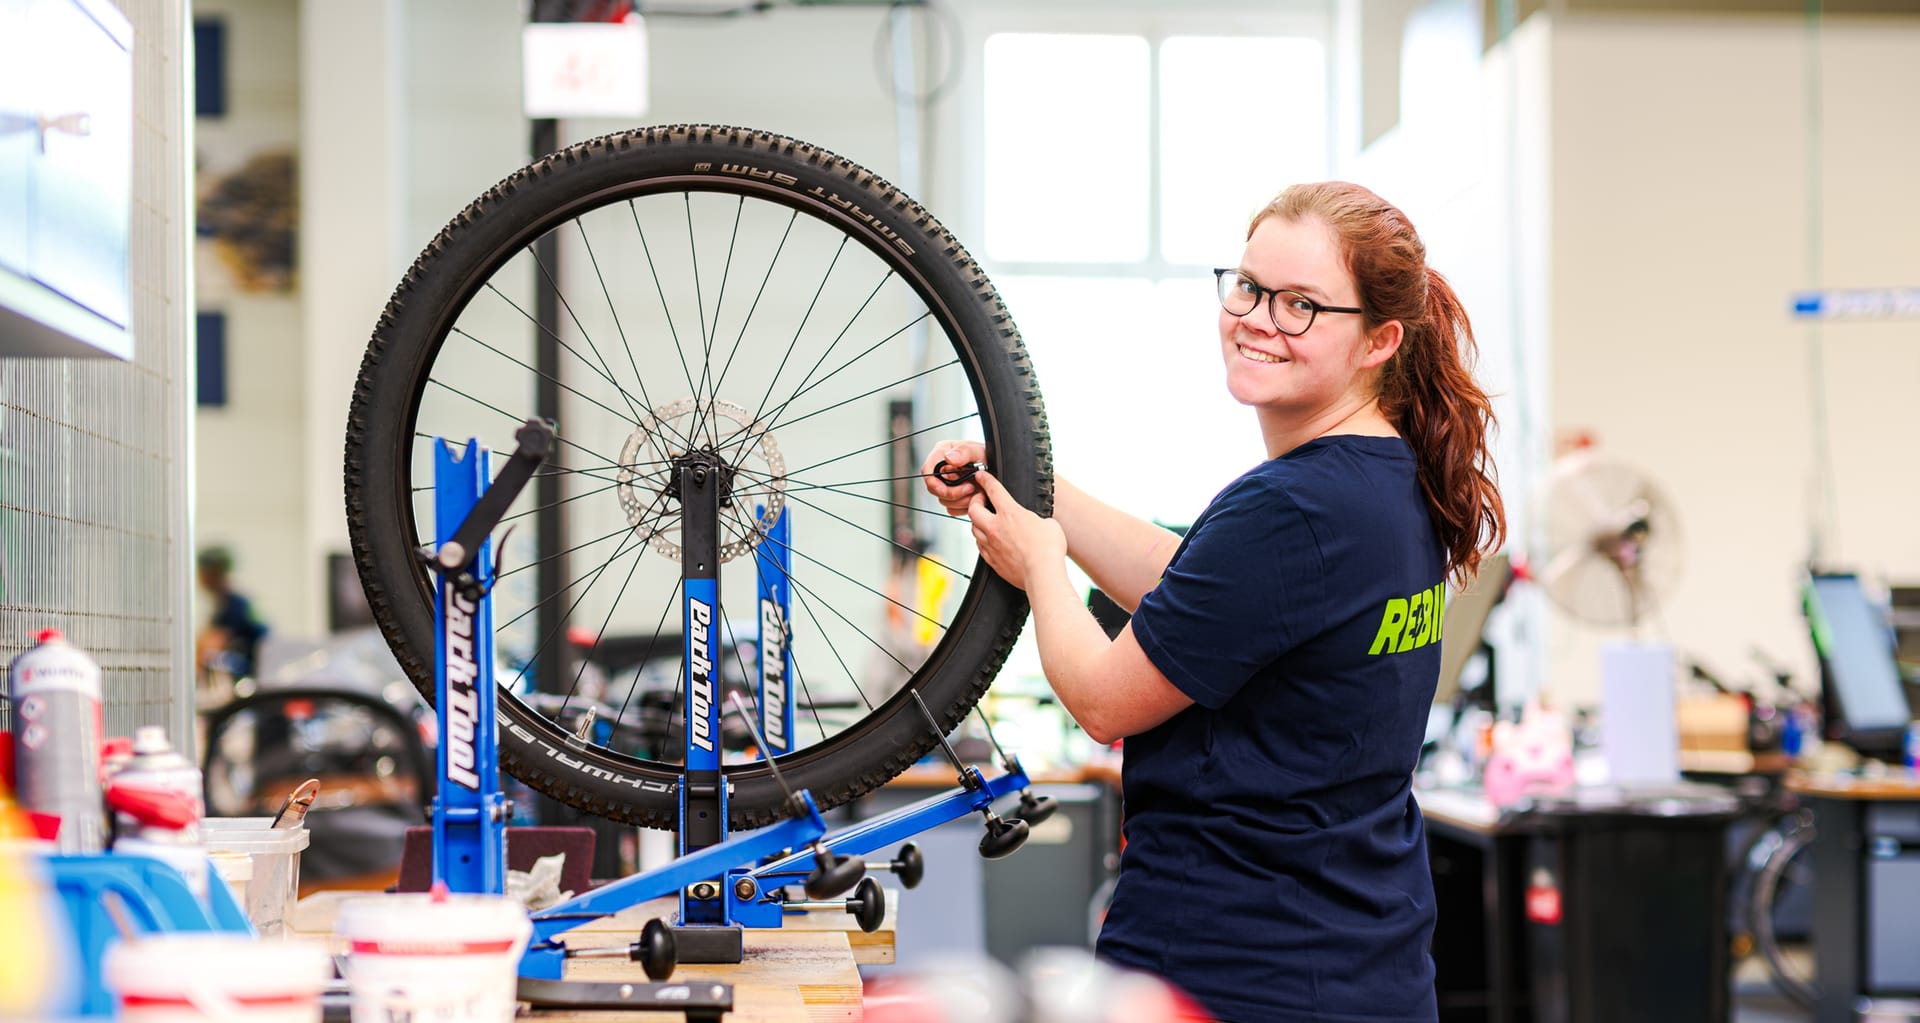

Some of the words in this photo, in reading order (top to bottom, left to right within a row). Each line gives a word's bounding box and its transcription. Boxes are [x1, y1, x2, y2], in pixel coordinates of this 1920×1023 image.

[721, 163, 798, 186] SAM
[807, 186, 916, 256] SMART
[496, 709, 675, 793] CHWALBE
